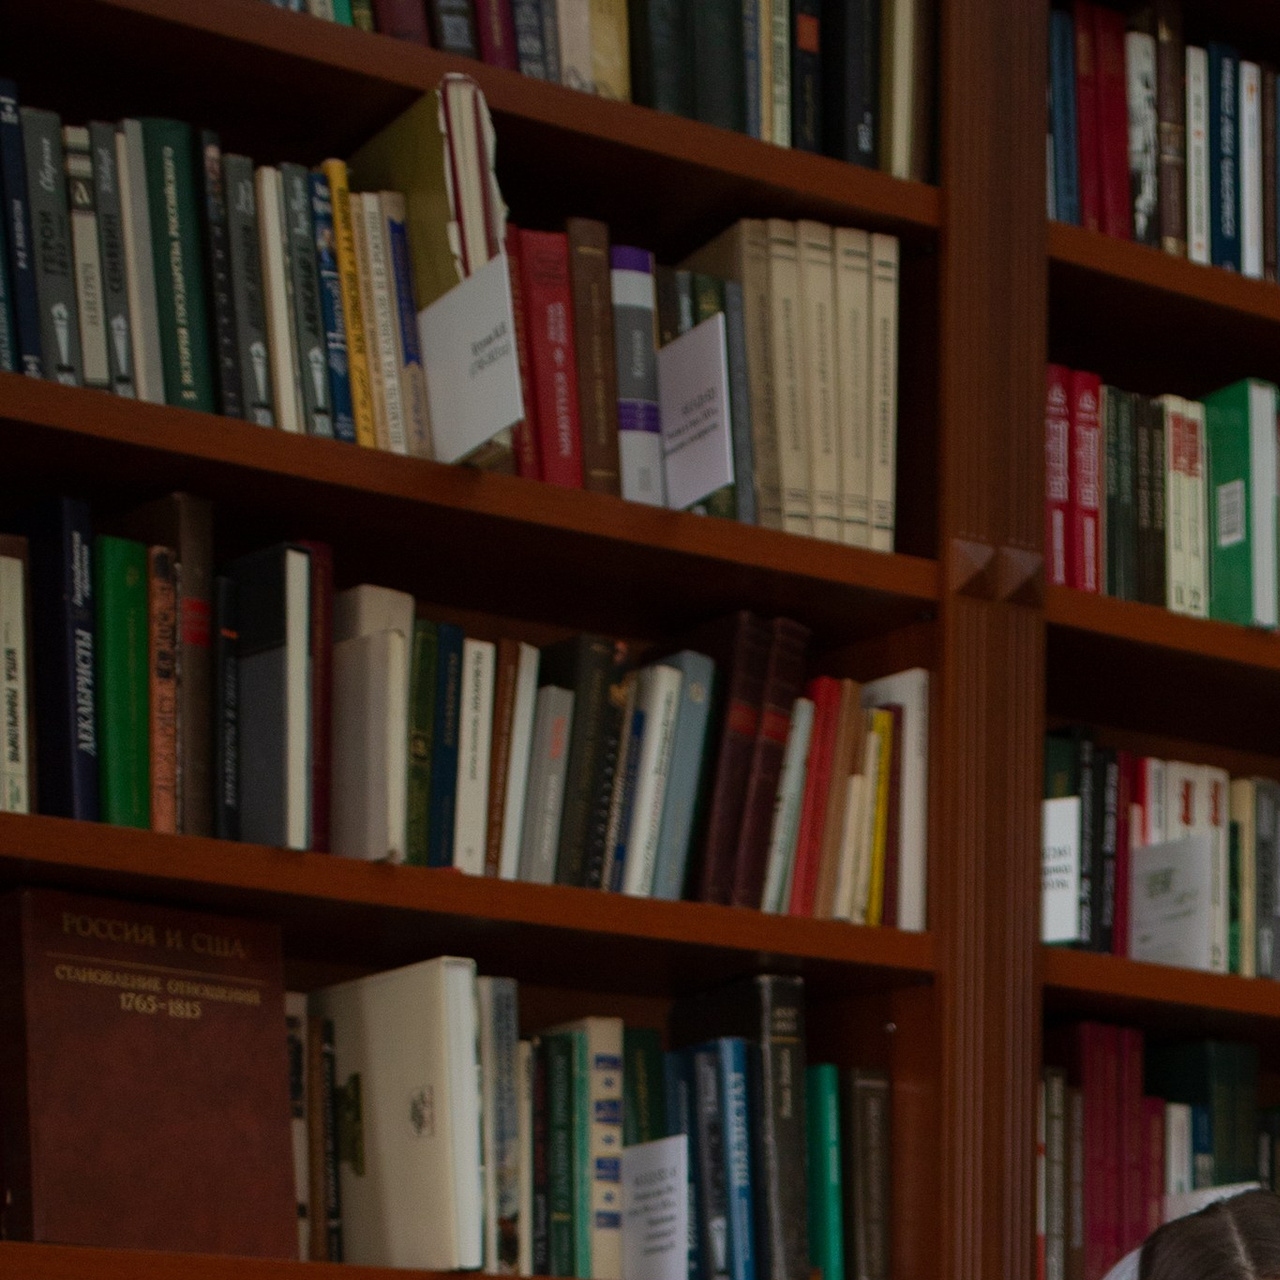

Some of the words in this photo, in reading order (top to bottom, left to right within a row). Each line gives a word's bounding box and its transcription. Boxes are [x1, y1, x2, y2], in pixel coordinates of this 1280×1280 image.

[75, 629, 97, 755] ДЕКАБРИСТЫ
[62, 911, 155, 948] РОССИЯ
[166, 928, 183, 950] И
[191, 932, 247, 959] США
[54, 963, 162, 992] СТАНОВЛЕНИЕ
[119, 992, 201, 1020] 1765-1815
